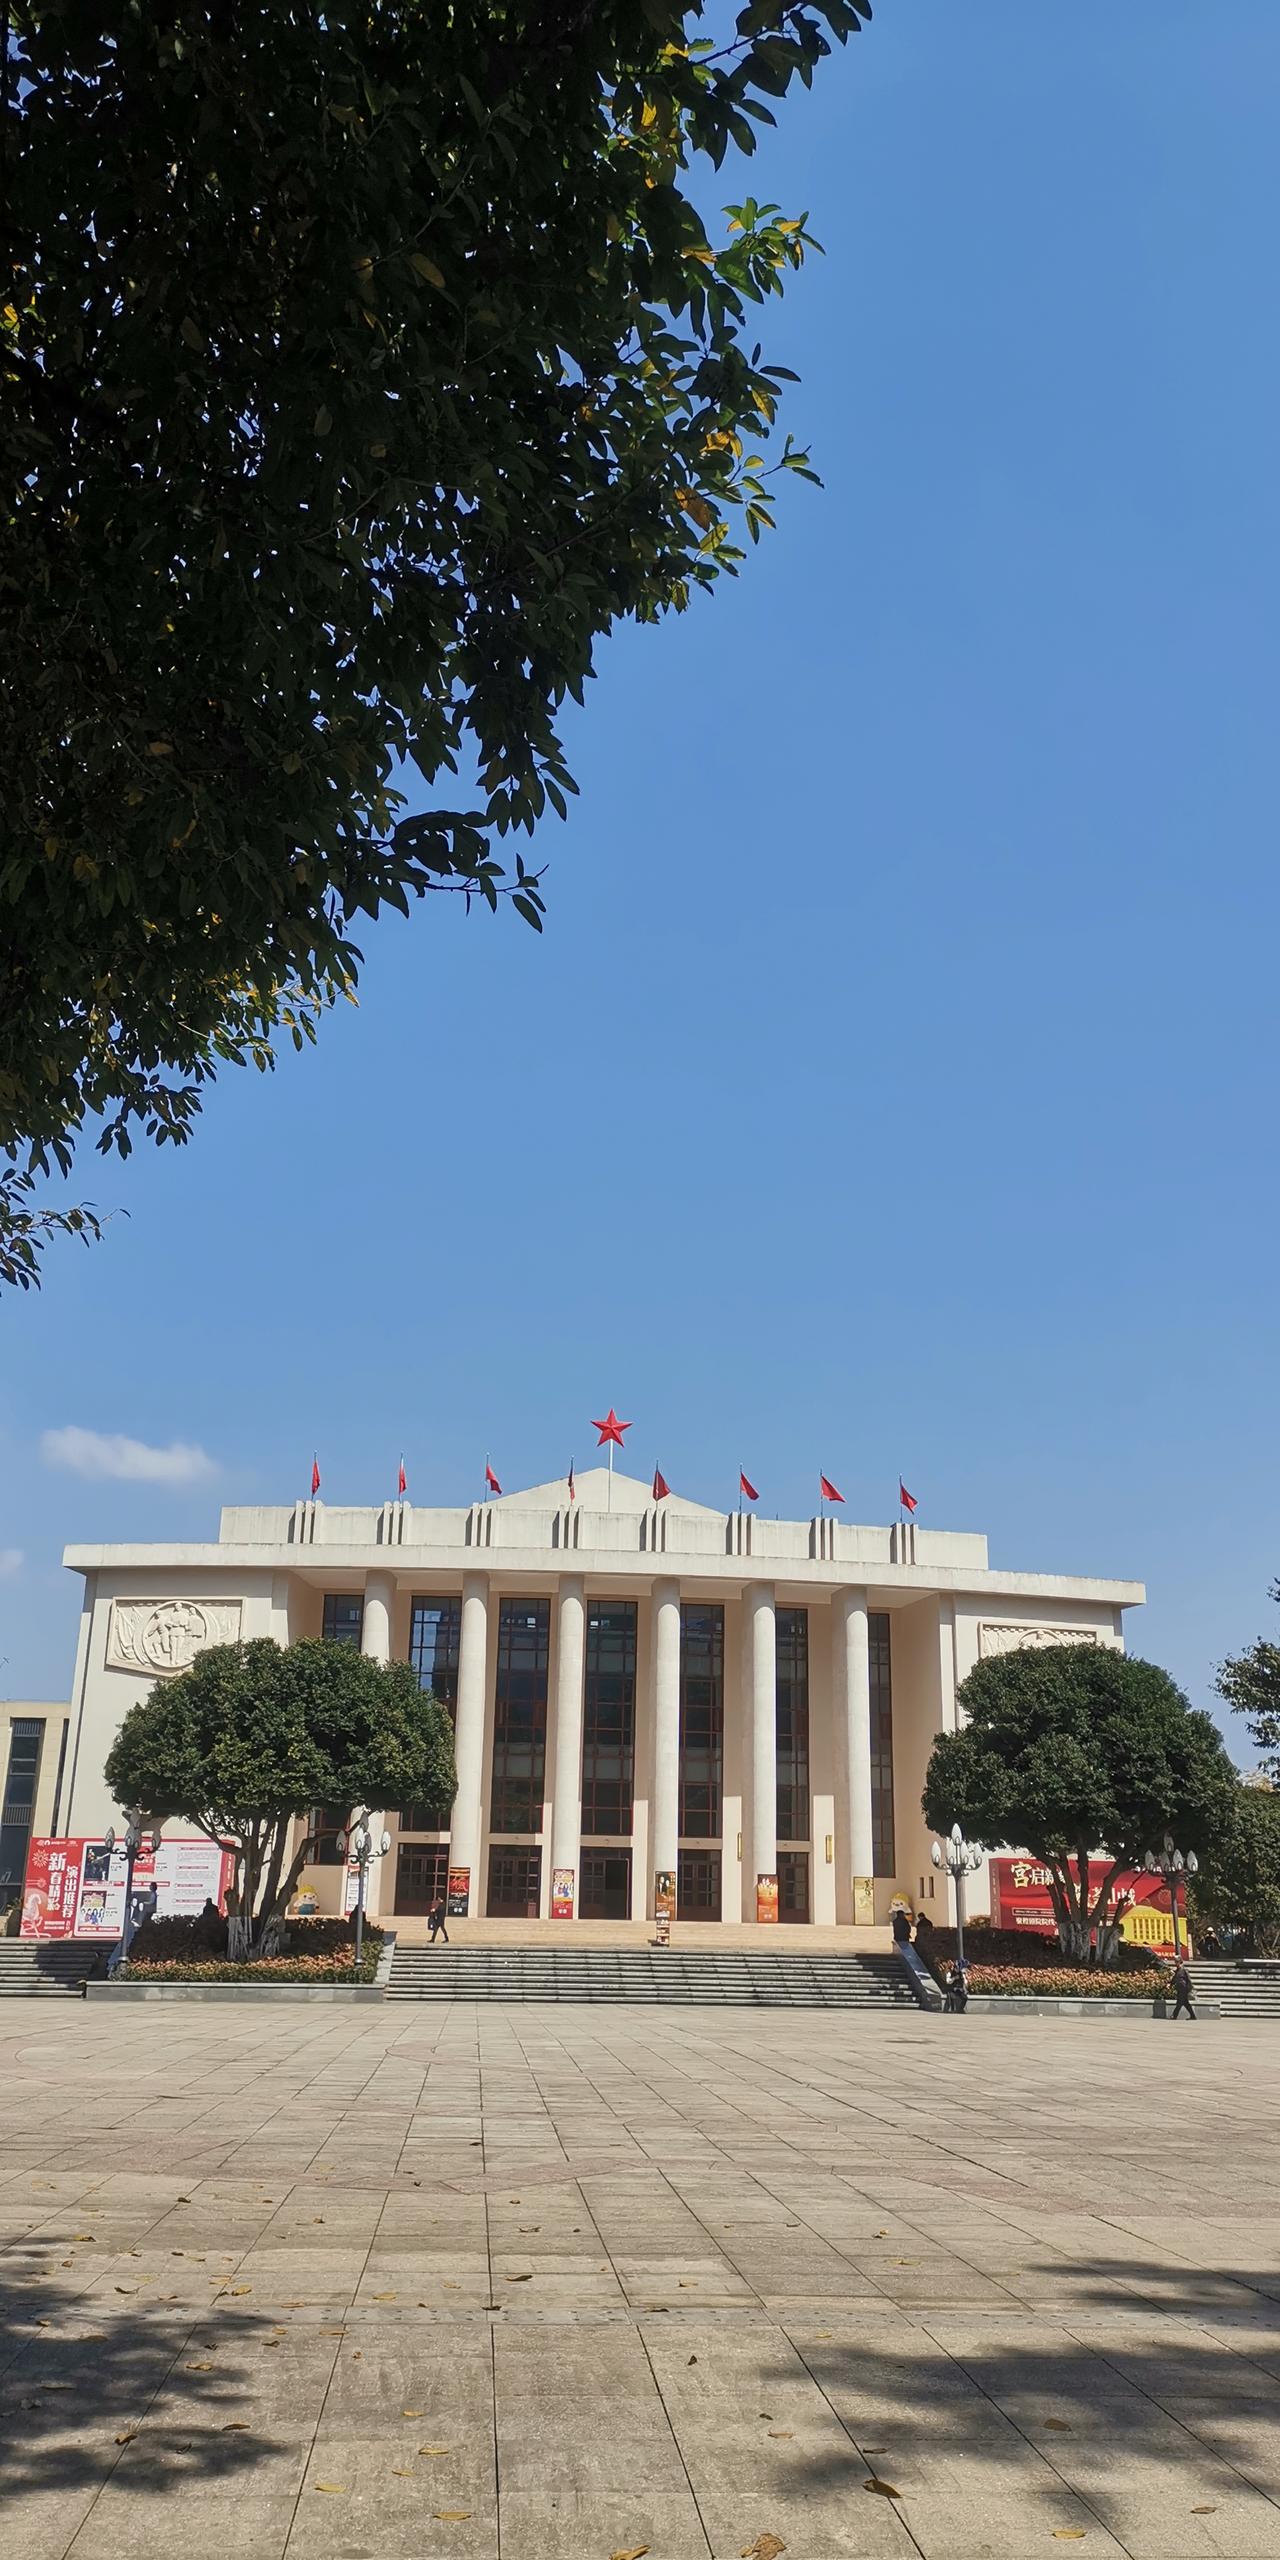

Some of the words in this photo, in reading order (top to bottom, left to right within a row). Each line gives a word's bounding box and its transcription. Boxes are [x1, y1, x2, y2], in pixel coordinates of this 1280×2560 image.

[47, 1852, 67, 1911] 新春精彩
[62, 1865, 79, 1918] 演出推荐
